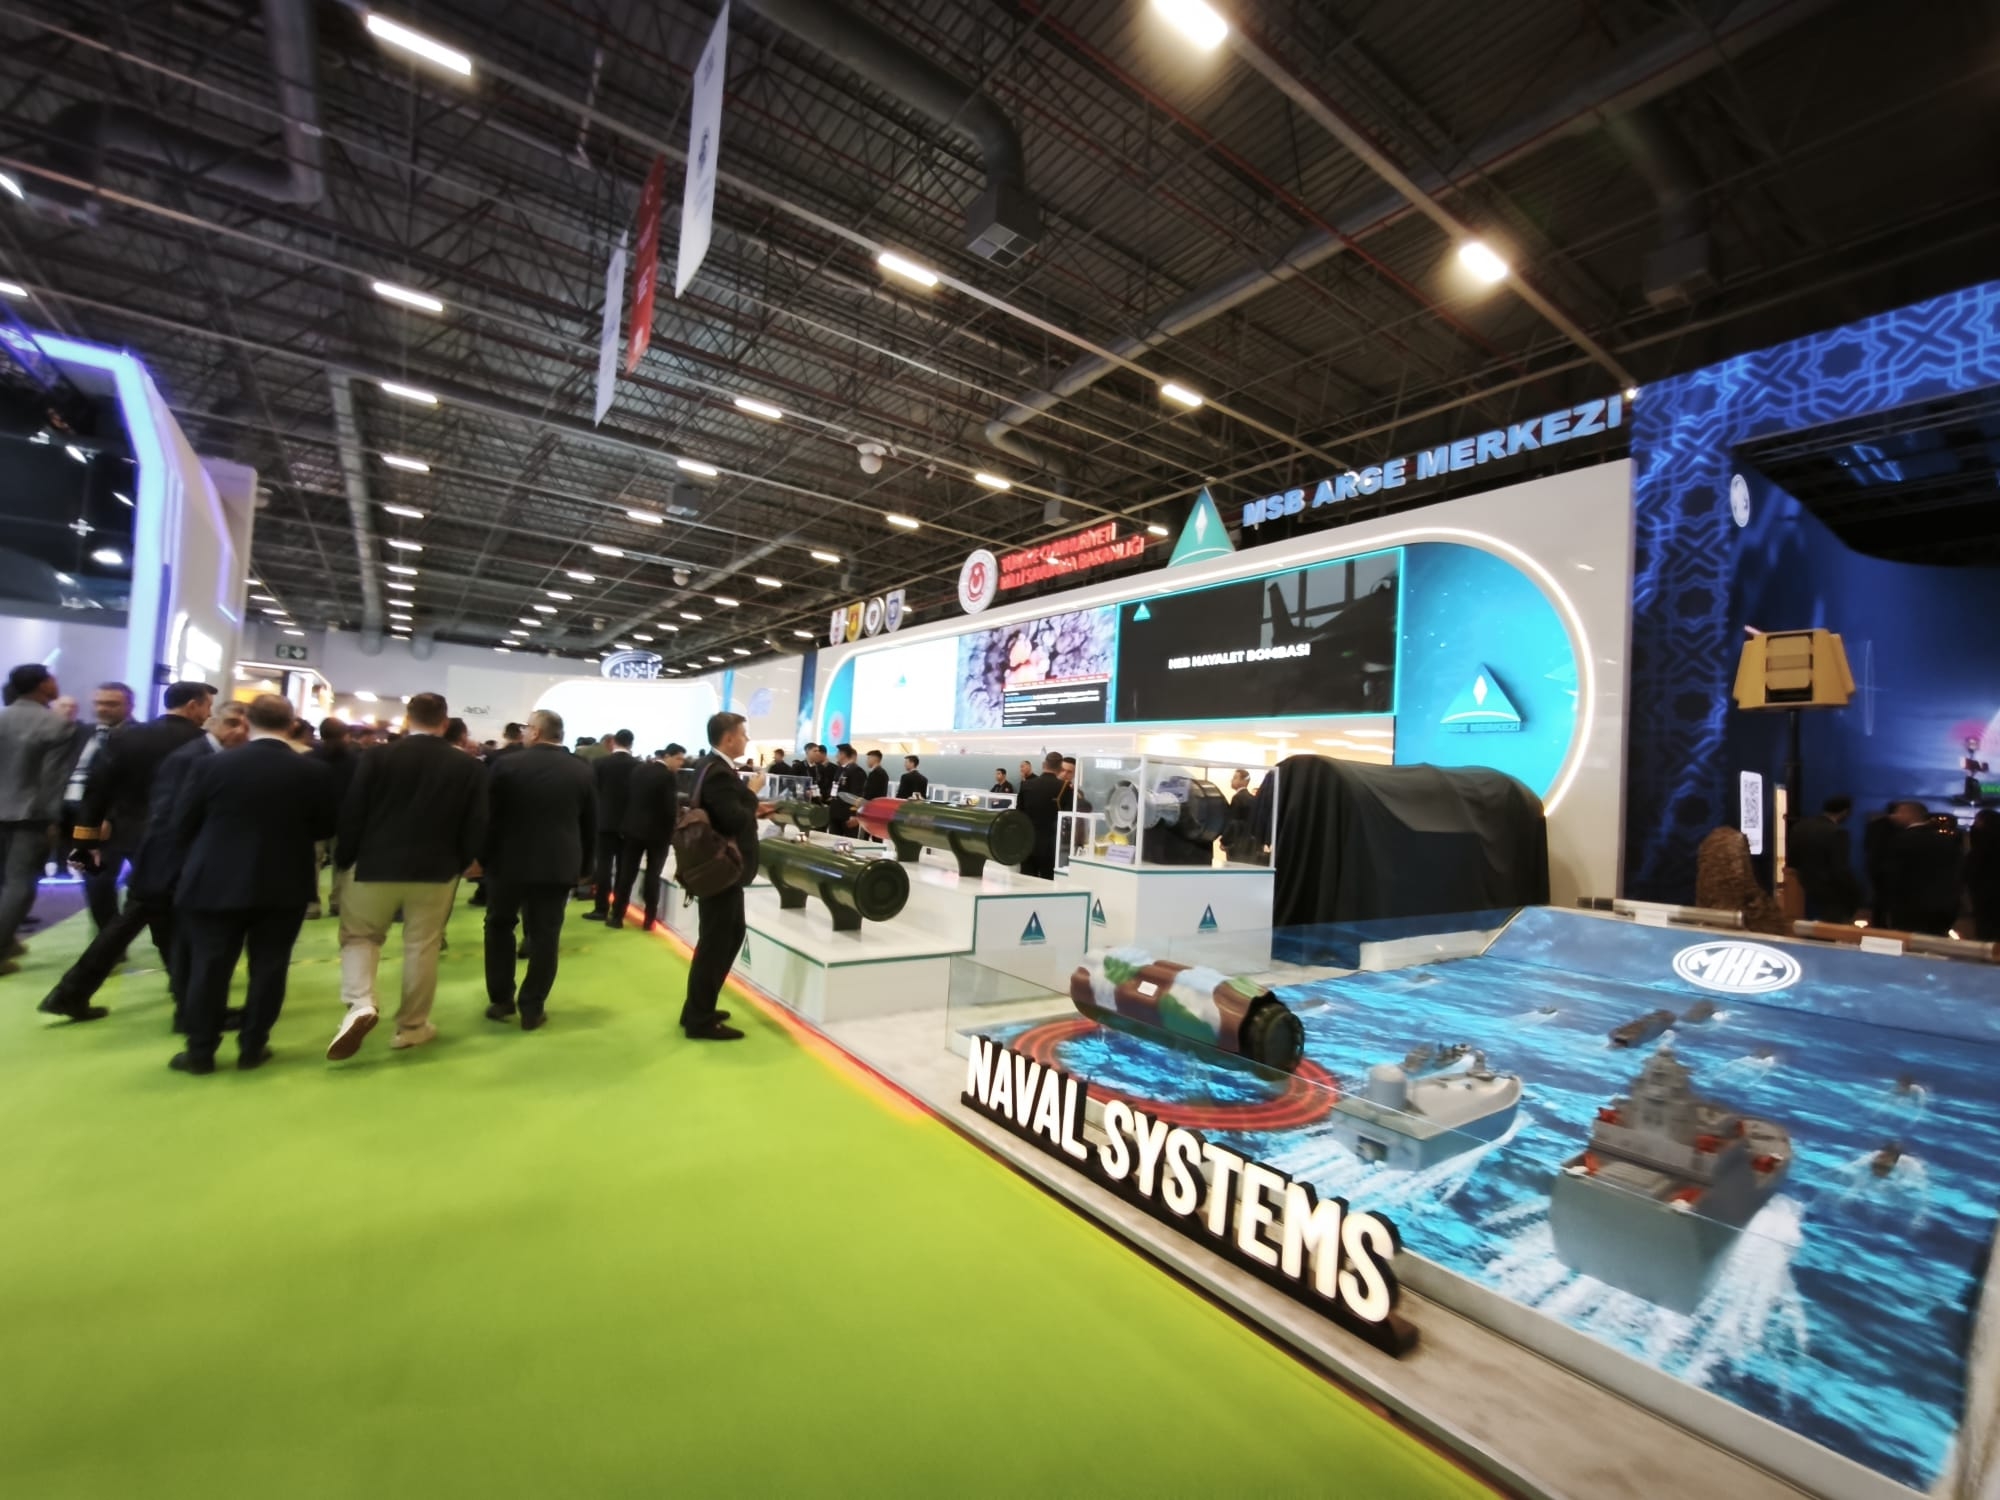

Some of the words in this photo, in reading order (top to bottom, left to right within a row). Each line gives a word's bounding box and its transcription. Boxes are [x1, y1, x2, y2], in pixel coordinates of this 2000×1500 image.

[1242, 488, 1305, 527] MSB
[1311, 457, 1407, 508] ARGE
[1192, 650, 1245, 667] HAYALET
[1246, 643, 1311, 662] BOMBASI
[966, 1035, 1088, 1161] NAVAL
[1099, 1100, 1398, 1323] SYSTEMS
